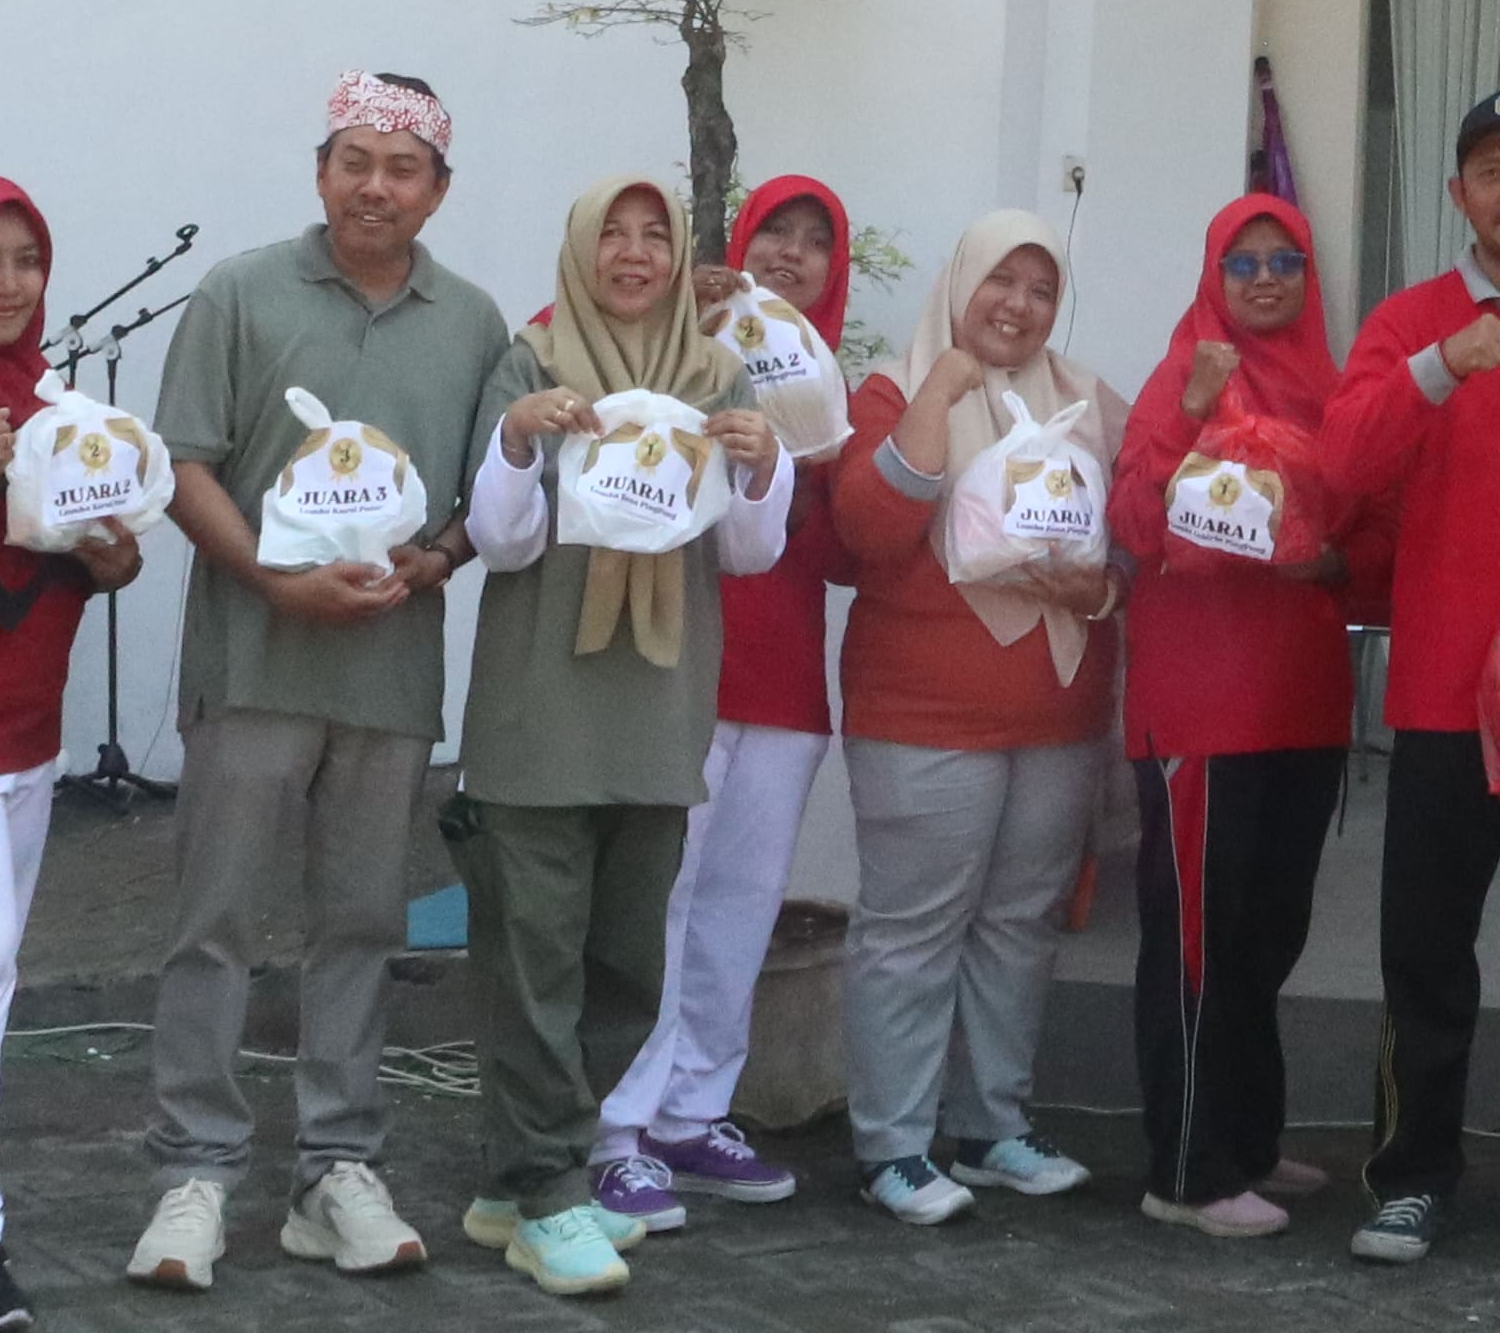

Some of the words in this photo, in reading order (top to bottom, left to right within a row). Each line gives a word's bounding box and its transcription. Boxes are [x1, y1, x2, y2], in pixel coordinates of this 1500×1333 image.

[788, 352, 800, 368] 2
[54, 481, 122, 507] JUARA
[123, 478, 132, 494] 2
[297, 487, 372, 506] JUARA
[376, 486, 388, 502] 3
[598, 475, 665, 505] JUARA
[667, 493, 676, 508] 1
[1020, 508, 1083, 525] JUARA
[1179, 511, 1245, 540] JUARA
[1250, 528, 1257, 541] 1
